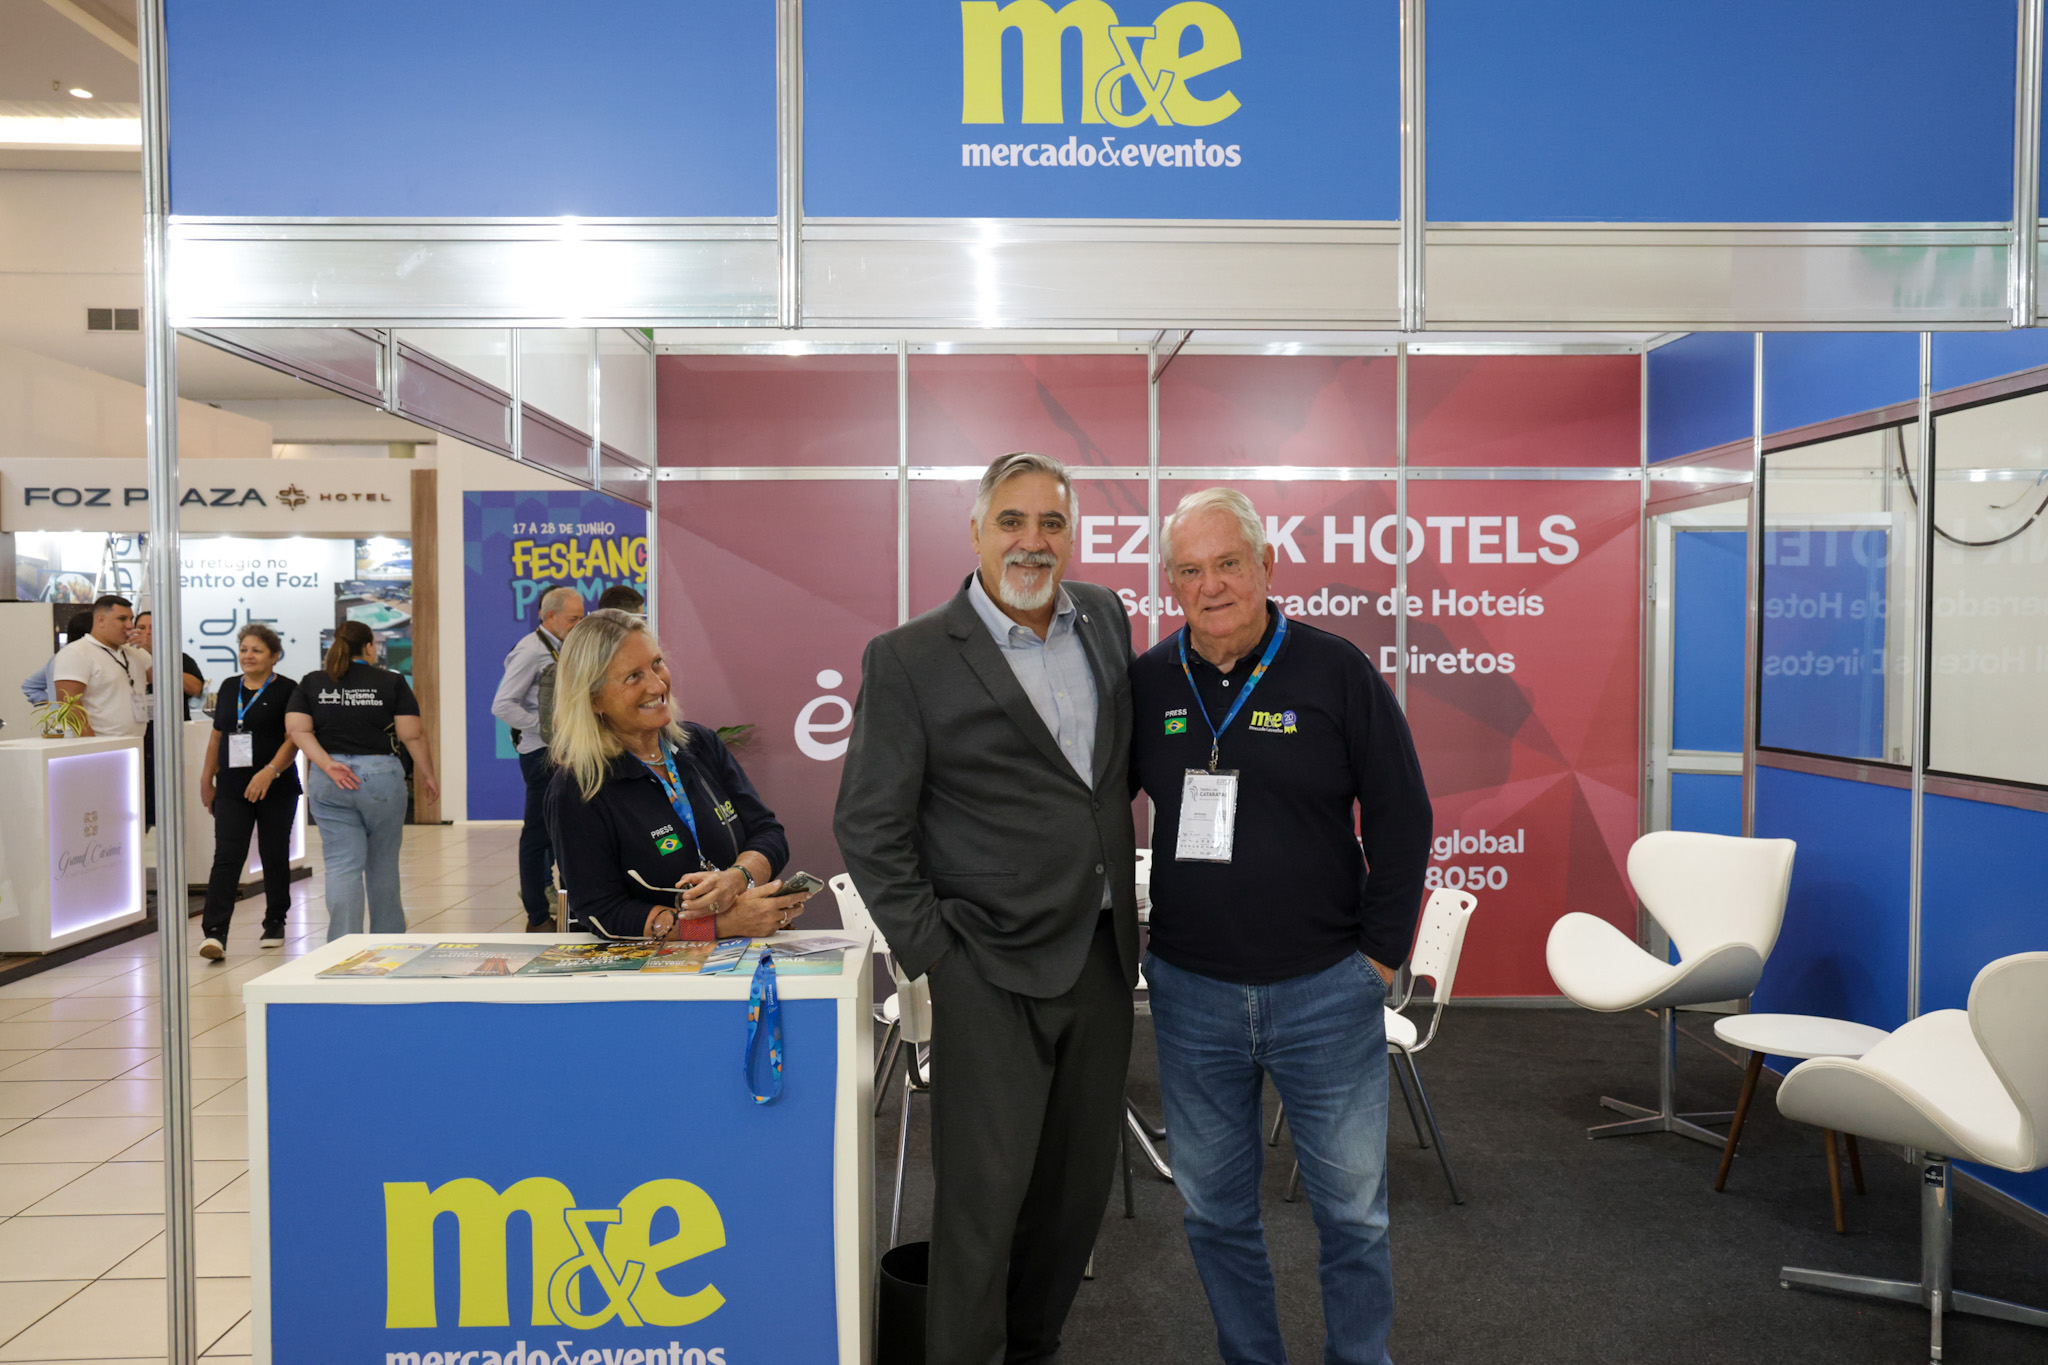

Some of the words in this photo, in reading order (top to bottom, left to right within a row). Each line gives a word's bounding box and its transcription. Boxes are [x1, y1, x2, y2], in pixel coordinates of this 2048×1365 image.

[961, 0, 1242, 128] m&e
[961, 136, 1242, 167] mercado&eventos
[24, 487, 111, 507] FOZ
[124, 487, 267, 507] PAZA
[319, 492, 392, 502] HOTEL
[512, 522, 526, 534] 17
[529, 522, 538, 534] A
[541, 522, 556, 535] 28
[558, 523, 573, 534] DE
[576, 521, 615, 536] JUNHO
[1323, 514, 1580, 566] HOTELS
[267, 559, 287, 568] no
[512, 536, 647, 583] FESTANÇ
[179, 573, 236, 588] entro
[242, 572, 269, 588] de
[276, 572, 319, 588] Foz!
[1119, 588, 1184, 617] Seu
[1376, 588, 1424, 617] de
[1380, 645, 1515, 674] Diretos
[345, 692, 375, 700] Turismo
[1165, 708, 1187, 718] PRESS
[1250, 711, 1282, 728] m&e
[650, 824, 674, 839] PRESS
[1424, 866, 1508, 890] 8050
[383, 1176, 726, 1330] m&e
